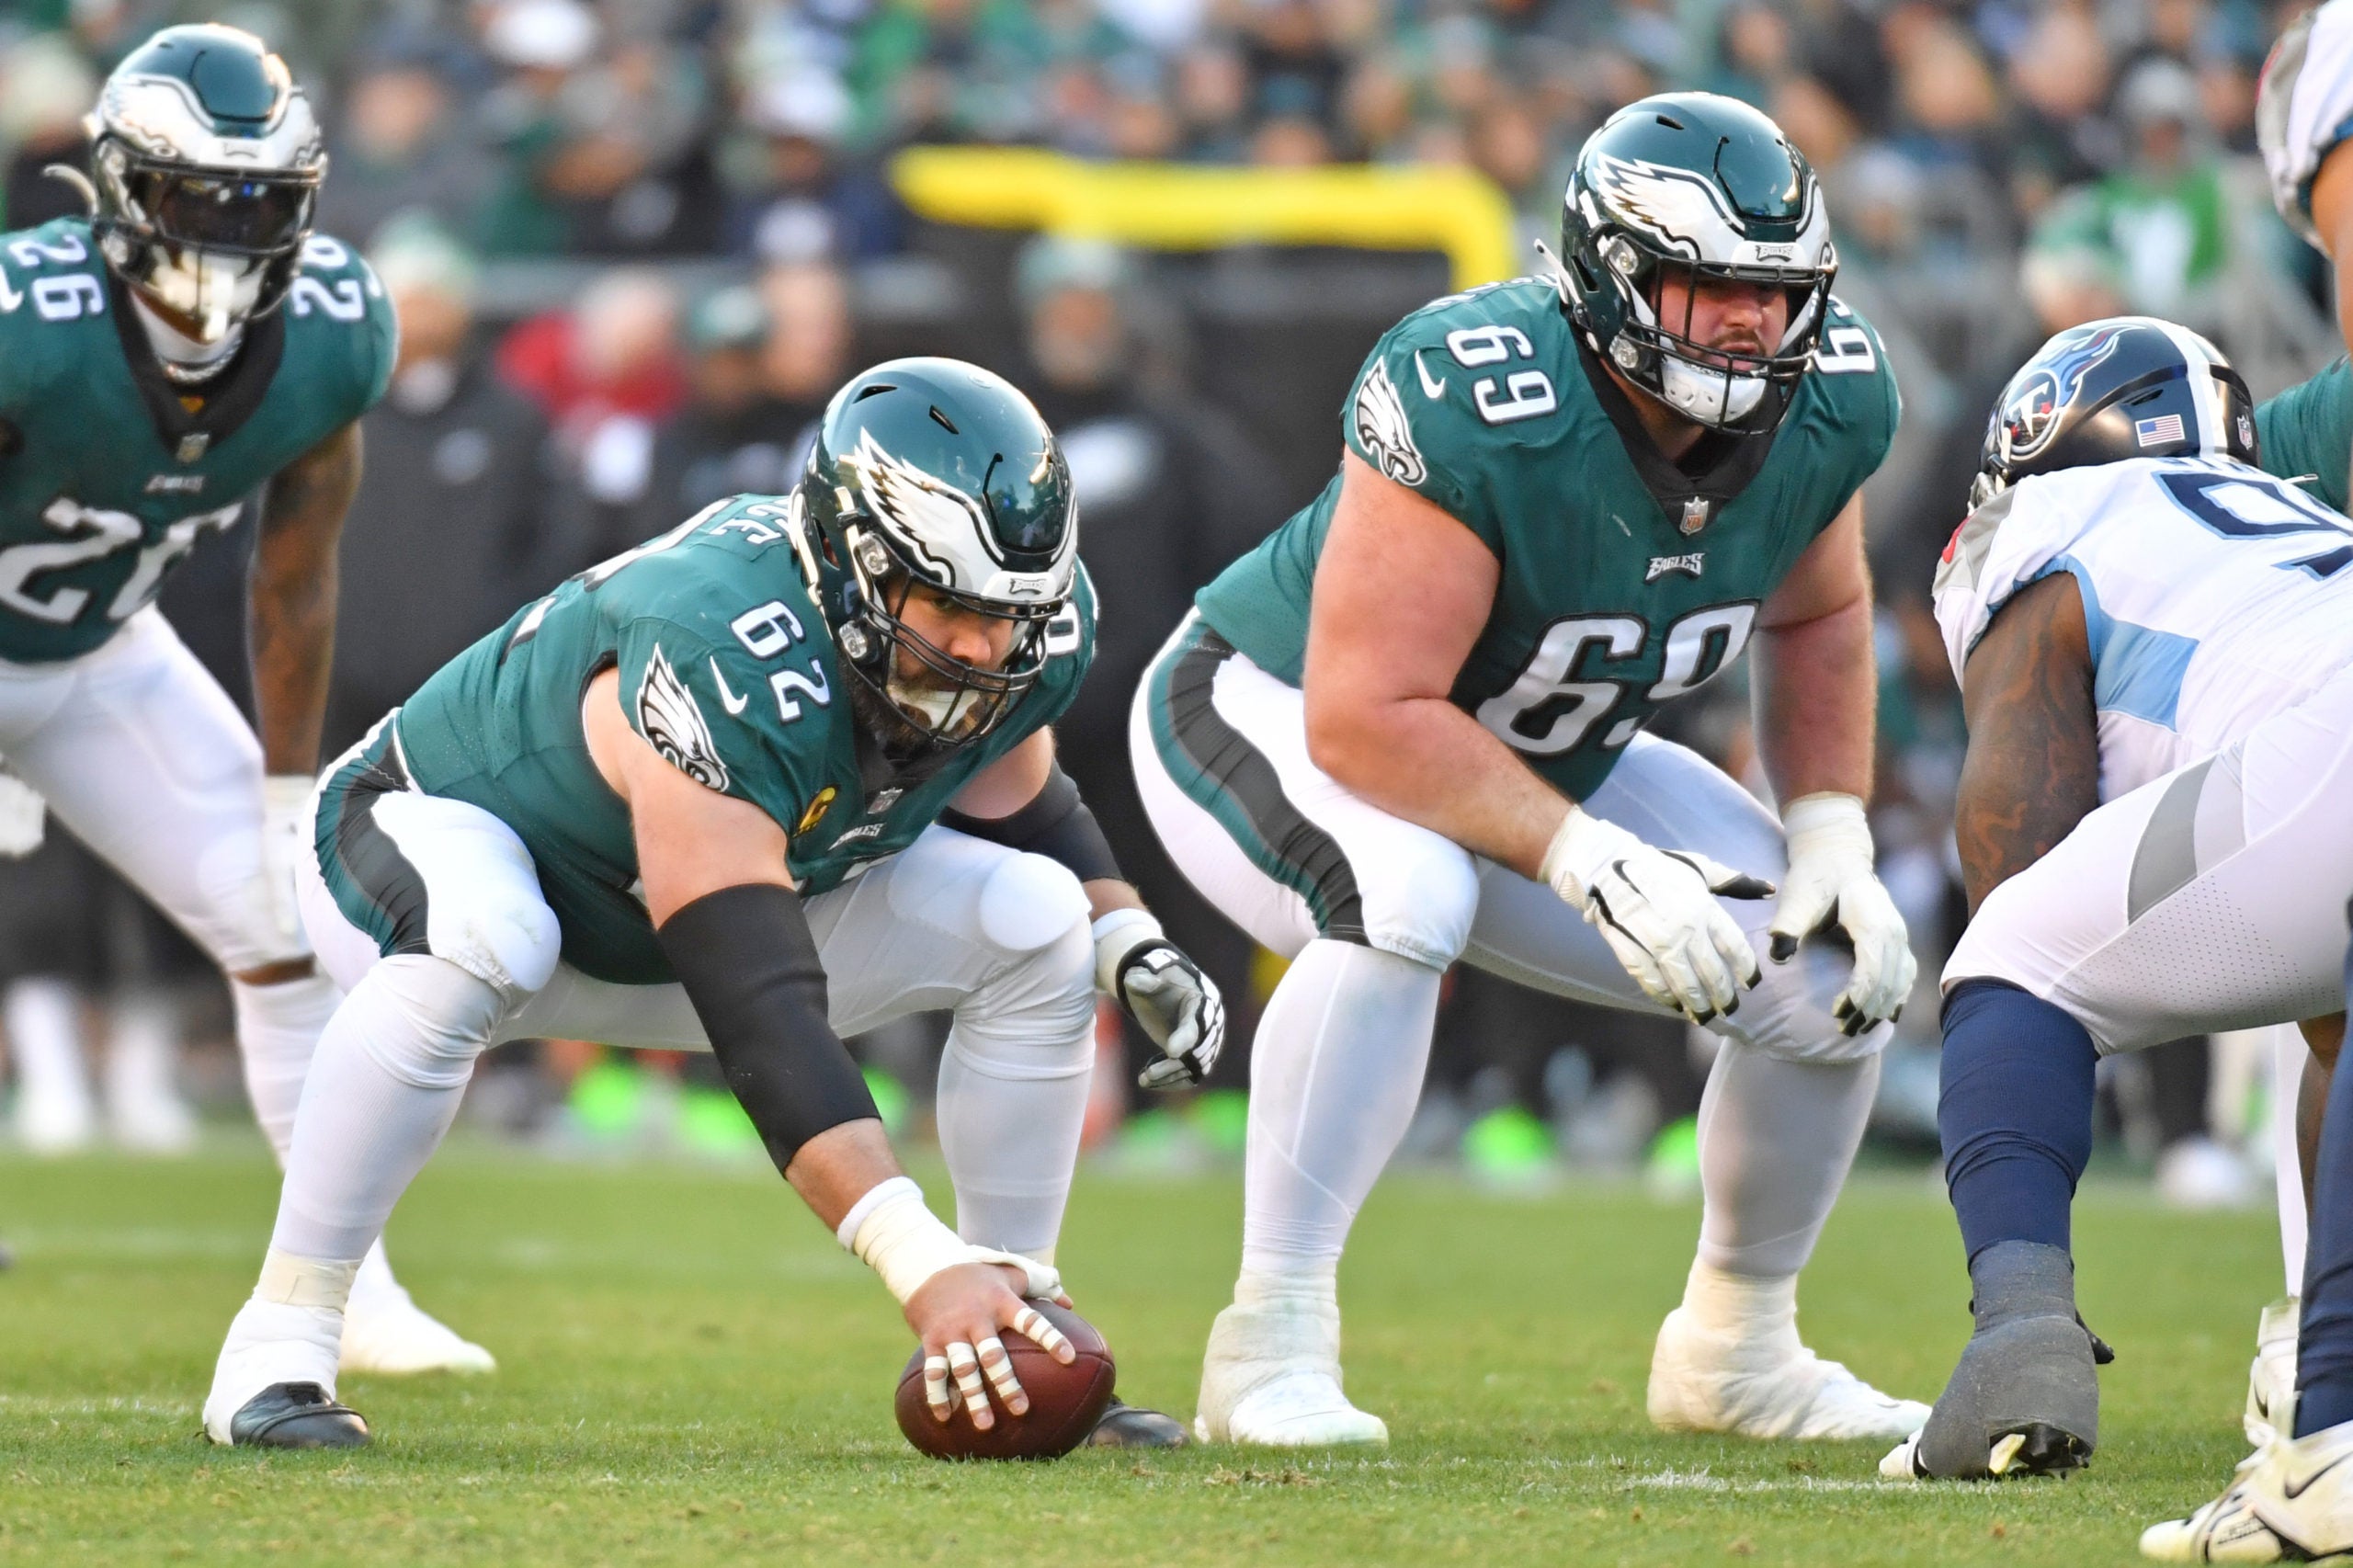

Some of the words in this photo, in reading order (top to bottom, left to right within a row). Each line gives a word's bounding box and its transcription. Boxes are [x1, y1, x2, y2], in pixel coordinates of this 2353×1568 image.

[6, 233, 106, 321] 26
[1446, 324, 1559, 426] 69
[1645, 552, 1705, 581] EAGLES
[729, 599, 832, 724] 62
